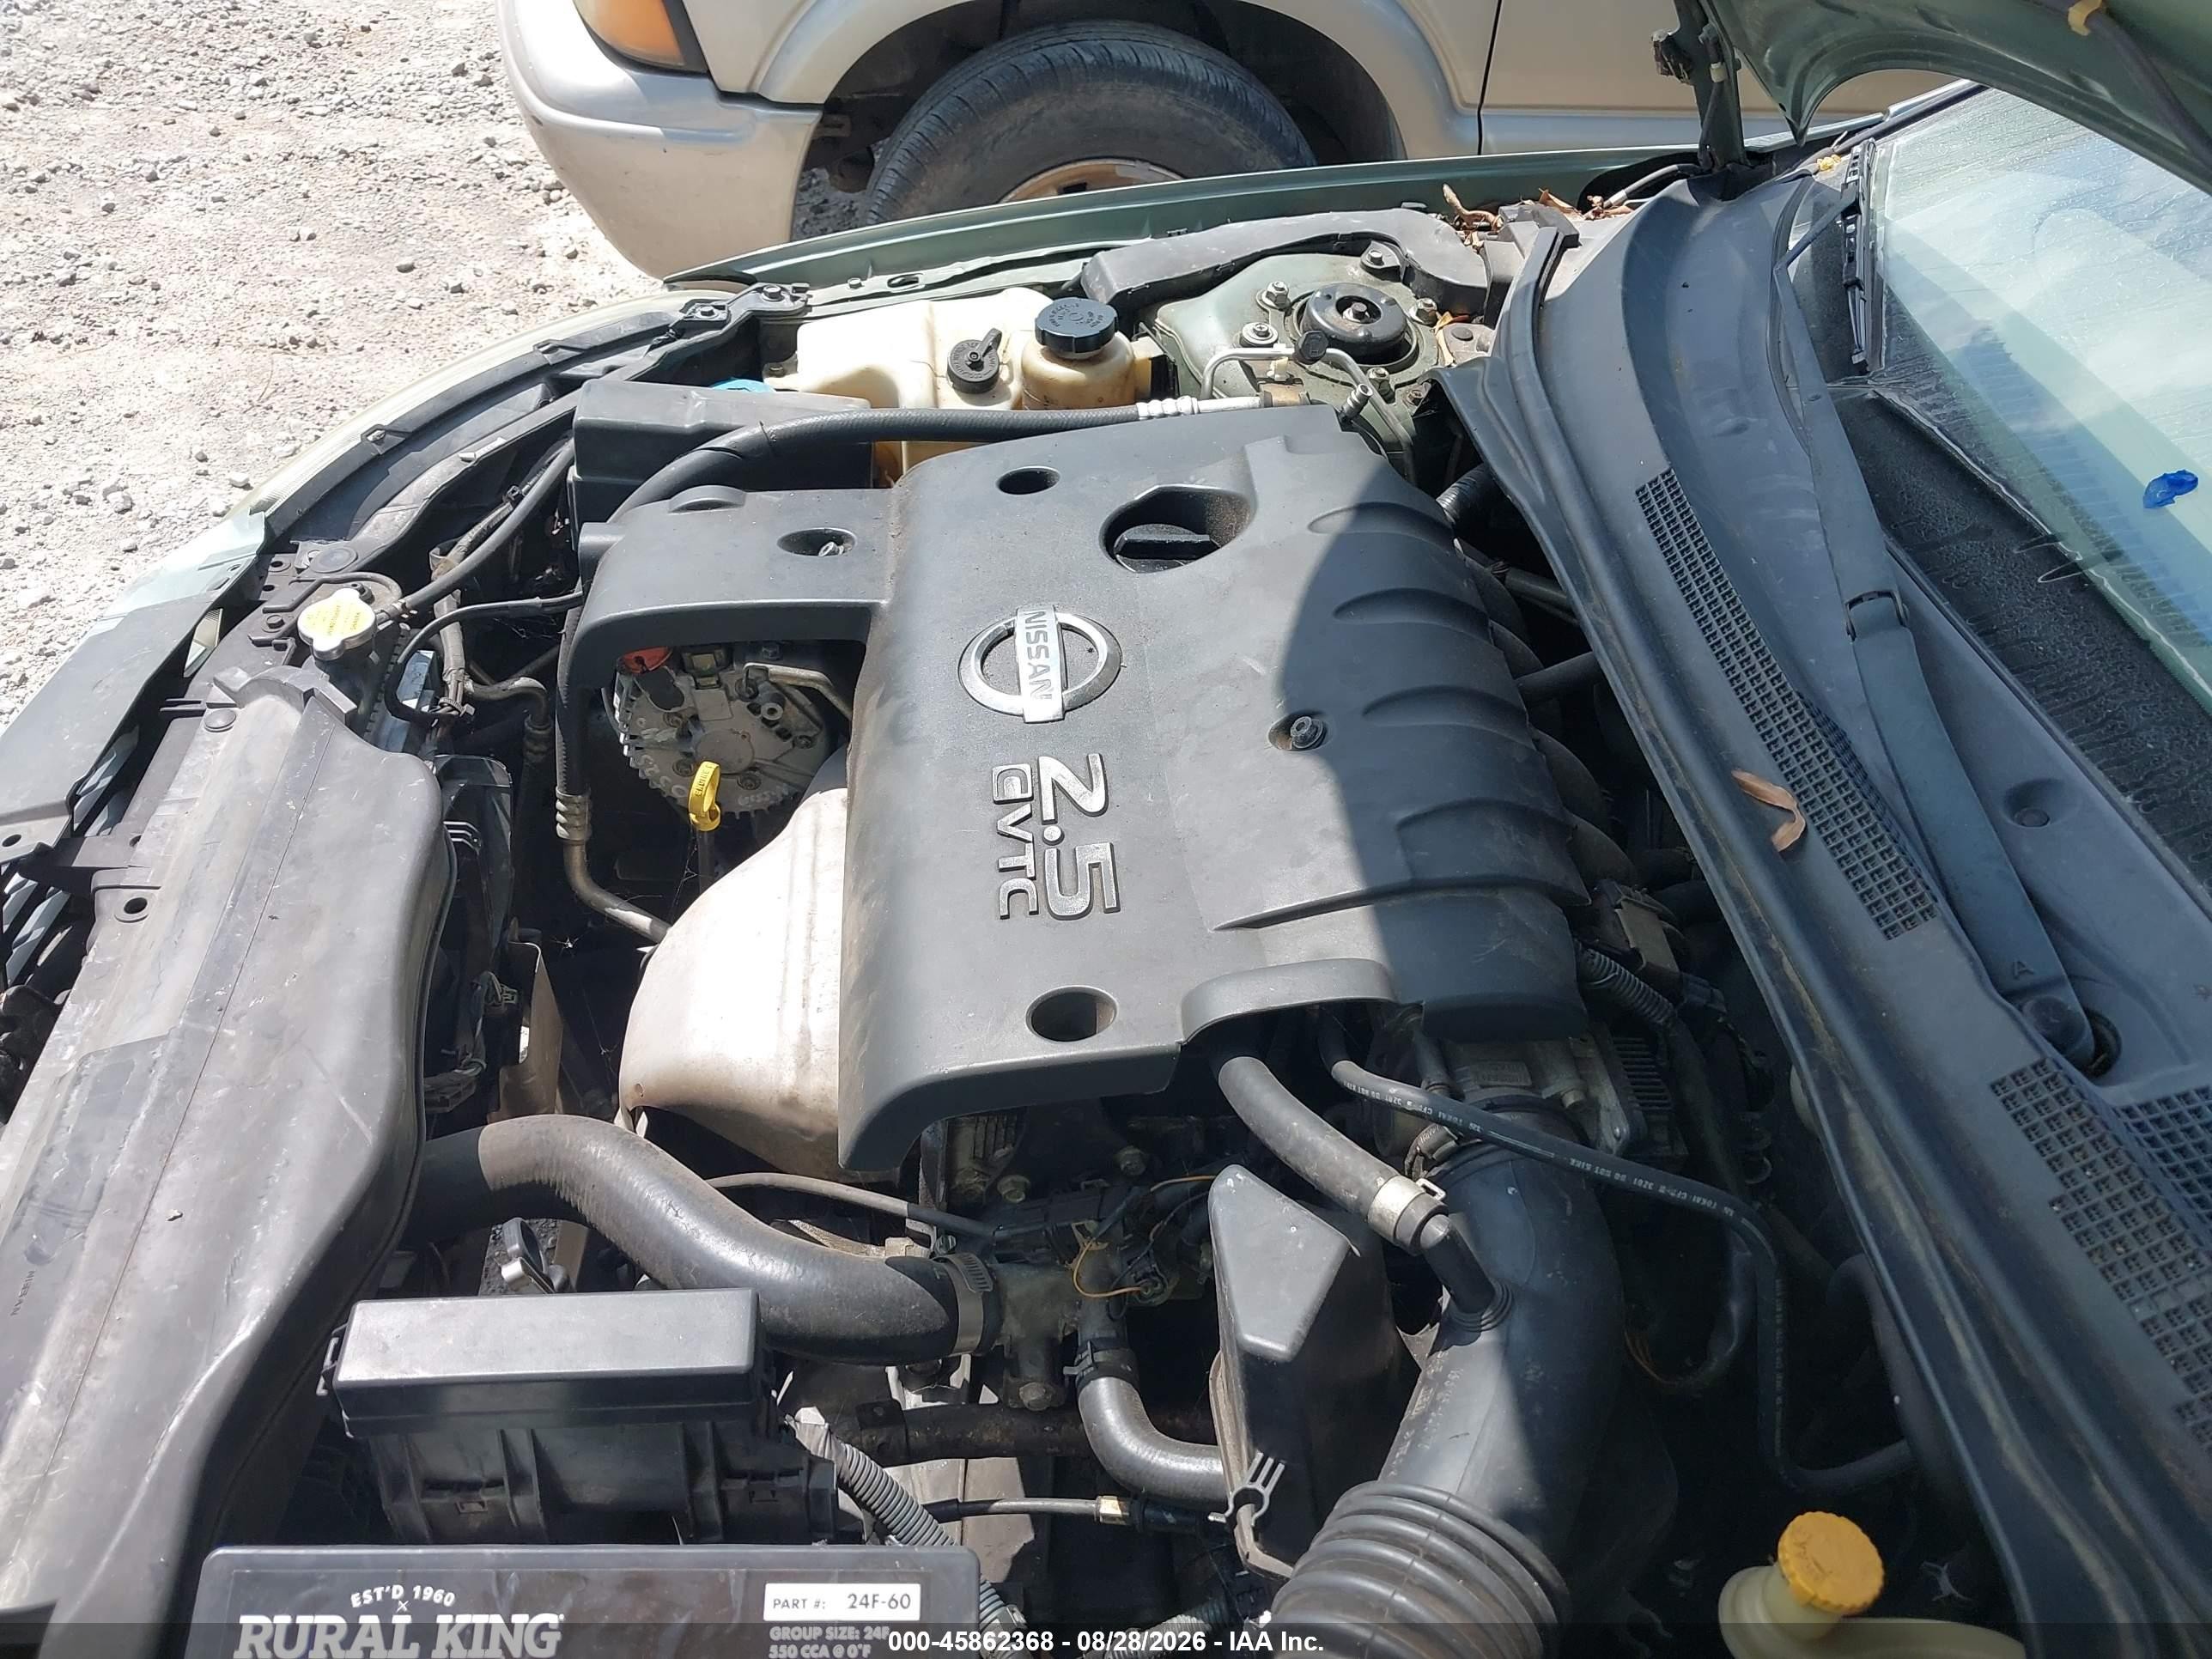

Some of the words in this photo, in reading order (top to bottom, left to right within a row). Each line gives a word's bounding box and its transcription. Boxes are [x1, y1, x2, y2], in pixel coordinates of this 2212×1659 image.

[1024, 609, 1052, 700] NISSAN
[1037, 753, 1121, 921] 2.5
[350, 1584, 404, 1608] EST'D
[413, 1585, 456, 1607] 1960
[773, 1598, 808, 1610] PART
[847, 1593, 912, 1610] 24F-60
[233, 1614, 420, 1659] RURAL
[431, 1613, 562, 1659] KING
[769, 1626, 823, 1641] GROUP
[825, 1626, 860, 1640] SIZE:
[863, 1626, 890, 1640] 24F
[769, 1644, 799, 1659] 550
[800, 1644, 830, 1659] CCA
[832, 1644, 845, 1658] @
